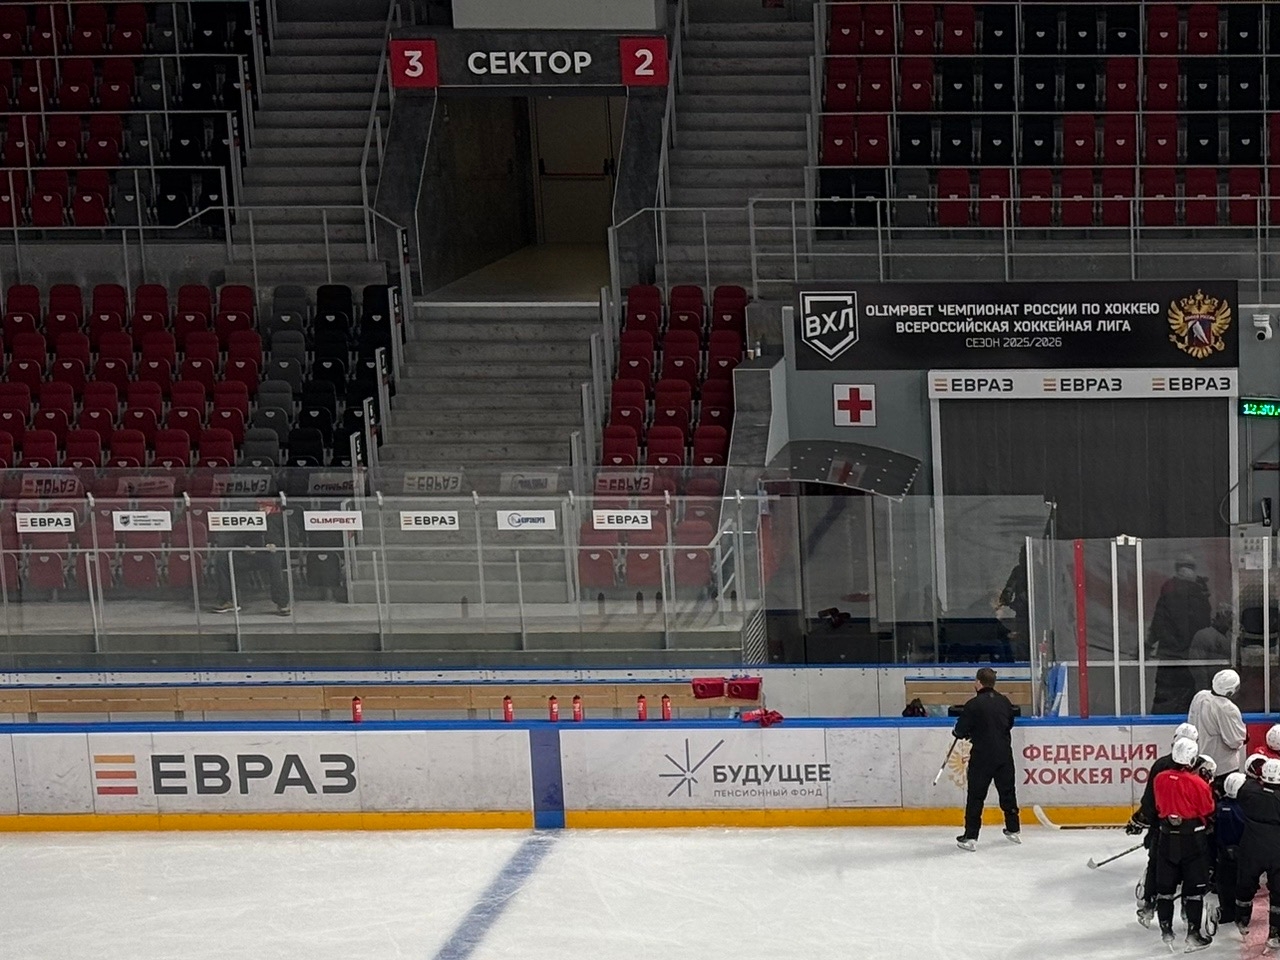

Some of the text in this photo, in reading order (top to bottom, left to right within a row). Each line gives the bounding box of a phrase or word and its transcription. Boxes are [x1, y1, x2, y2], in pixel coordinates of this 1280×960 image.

[404, 49, 654, 77] 3 СЕКТОР 2
[865, 302, 1160, 316] OLIMPBET ЧЕМПИОНАТ РОССИИ ПО ХОККЕЮ
[805, 308, 854, 338] ВХЛ
[896, 316, 1131, 333] ВСЕРОССИЙСКАЯ ХОККЕЙНАЯ ЛИГА
[965, 337, 1062, 348] СЕЗОН 2025/2026
[951, 378, 1014, 392] ЕВРАЗ
[1060, 378, 1123, 392] ЕВРАЗ
[1168, 377, 1231, 391] ЕВРАЗ
[30, 518, 72, 527] ЕВРАЗ
[222, 516, 264, 526] ЕВРАЗ
[414, 516, 456, 525] ЕВРАЗ
[607, 515, 649, 524] ЕВРАЗ
[1023, 744, 1158, 764] ФЕДЕРАЦИЯ
[151, 754, 357, 795] ЕВРАЗ
[713, 763, 831, 786] БУДУЩЕЕ
[1022, 768, 1113, 785] ХОККЕЯ
[713, 788, 823, 798] ПЕНСИОННЫЙ ФОНД
